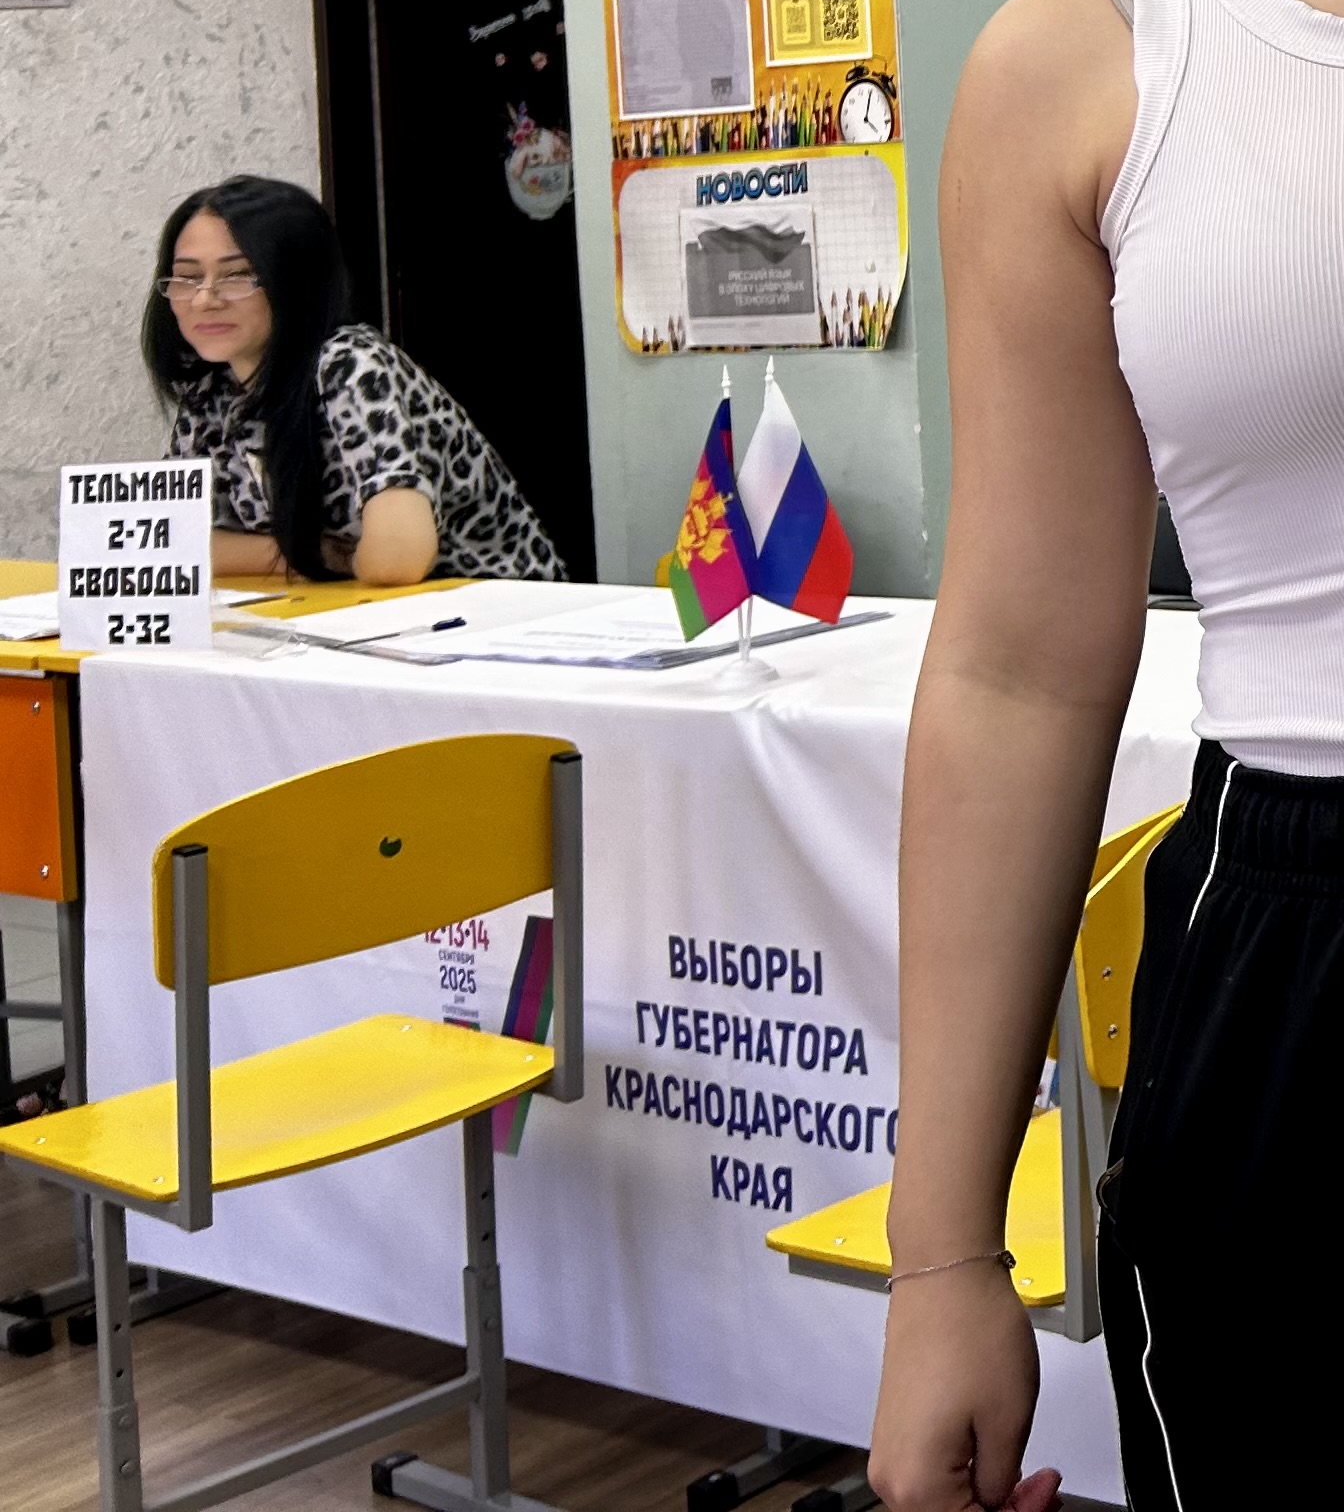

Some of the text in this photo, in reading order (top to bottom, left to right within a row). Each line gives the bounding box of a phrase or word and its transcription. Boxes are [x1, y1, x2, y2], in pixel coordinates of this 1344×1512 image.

[696, 161, 809, 208] НОВОСТИ
[69, 468, 204, 505] ТЕЛЬМАНА
[108, 517, 170, 550] 2-7А
[69, 565, 200, 599] СВОБОДЫ
[108, 613, 171, 645] 2-32
[439, 965, 477, 995] 2025
[668, 934, 824, 997] ВЫБОРЫ
[635, 1001, 869, 1076] ГУБЕРНАТОРА
[709, 1154, 793, 1214] КРАЯ
